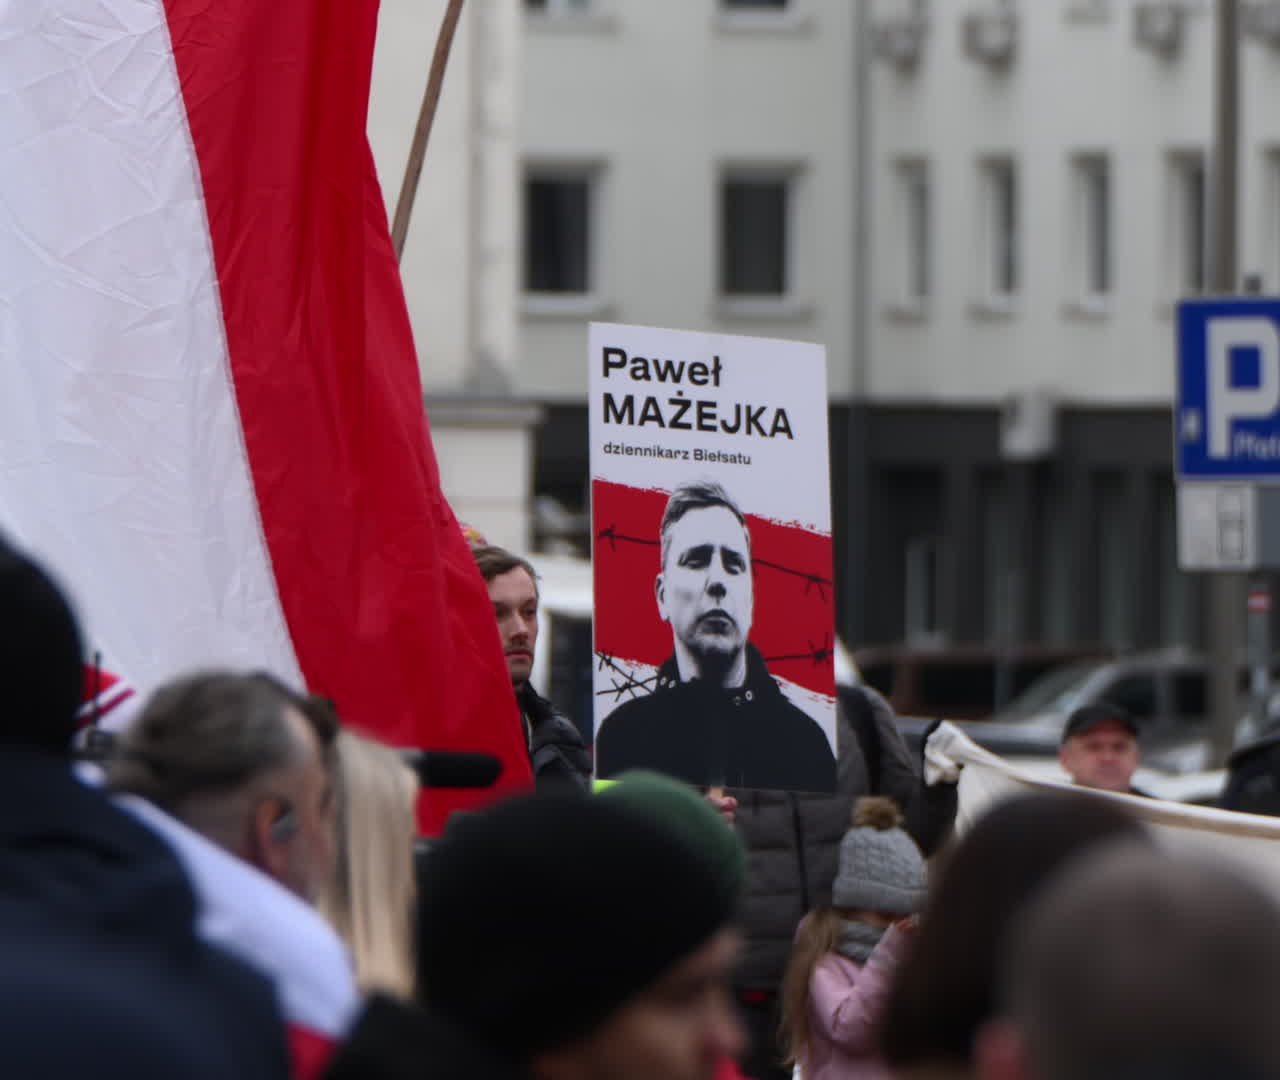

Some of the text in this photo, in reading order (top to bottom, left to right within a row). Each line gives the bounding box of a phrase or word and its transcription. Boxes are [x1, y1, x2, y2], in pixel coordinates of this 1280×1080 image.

[602, 347, 722, 387] Paweł
[603, 390, 794, 440] MAŻEJKA
[603, 442, 689, 460] dziennikarz
